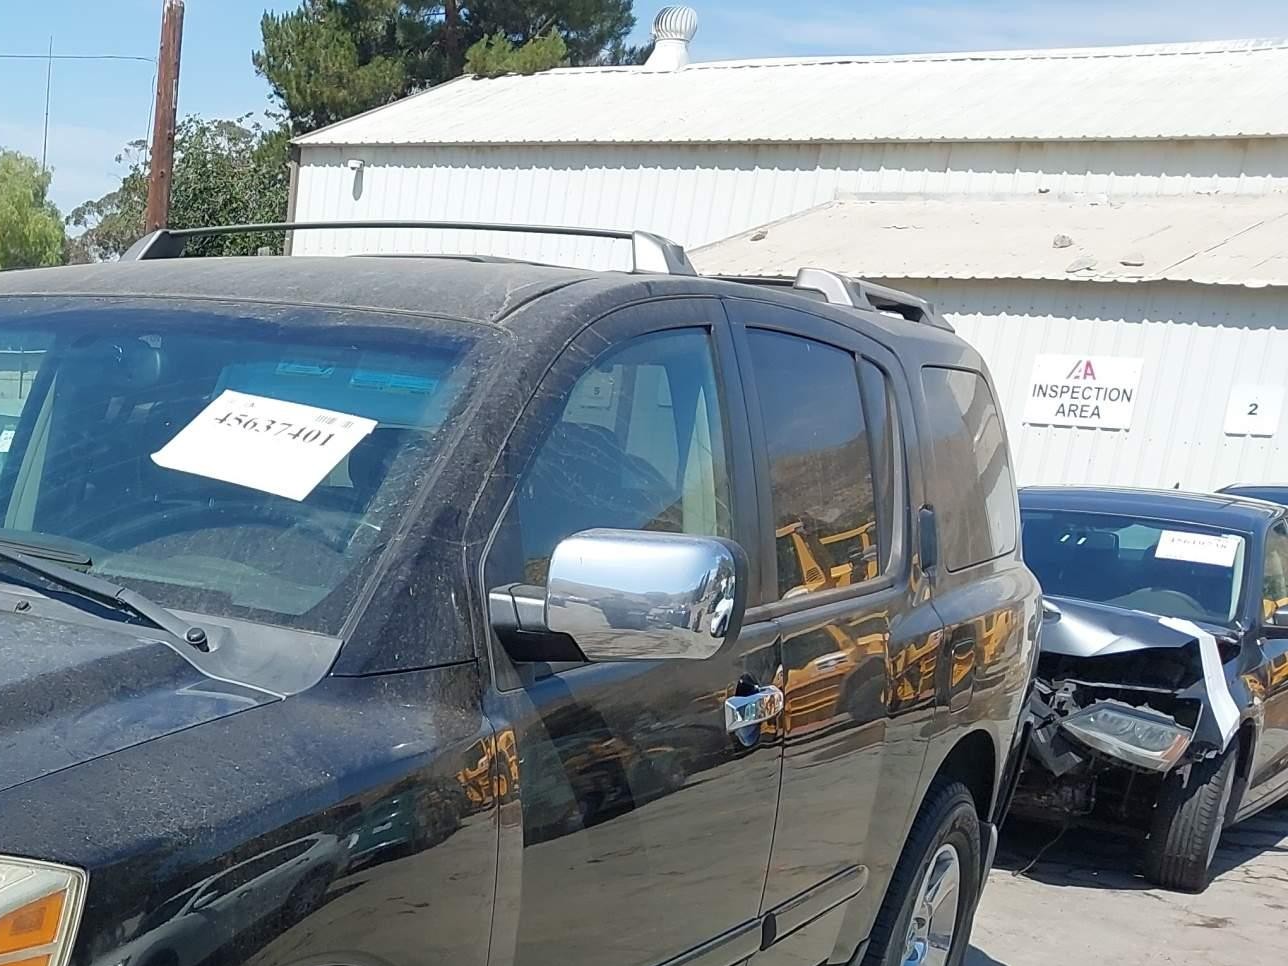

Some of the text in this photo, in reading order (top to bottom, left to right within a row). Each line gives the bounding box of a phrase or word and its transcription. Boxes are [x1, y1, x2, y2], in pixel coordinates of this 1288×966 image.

[1031, 383, 1133, 403] INSPECTION
[1054, 402, 1101, 420] AREA
[1247, 403, 1259, 416] 2
[214, 411, 335, 447] 45637401
